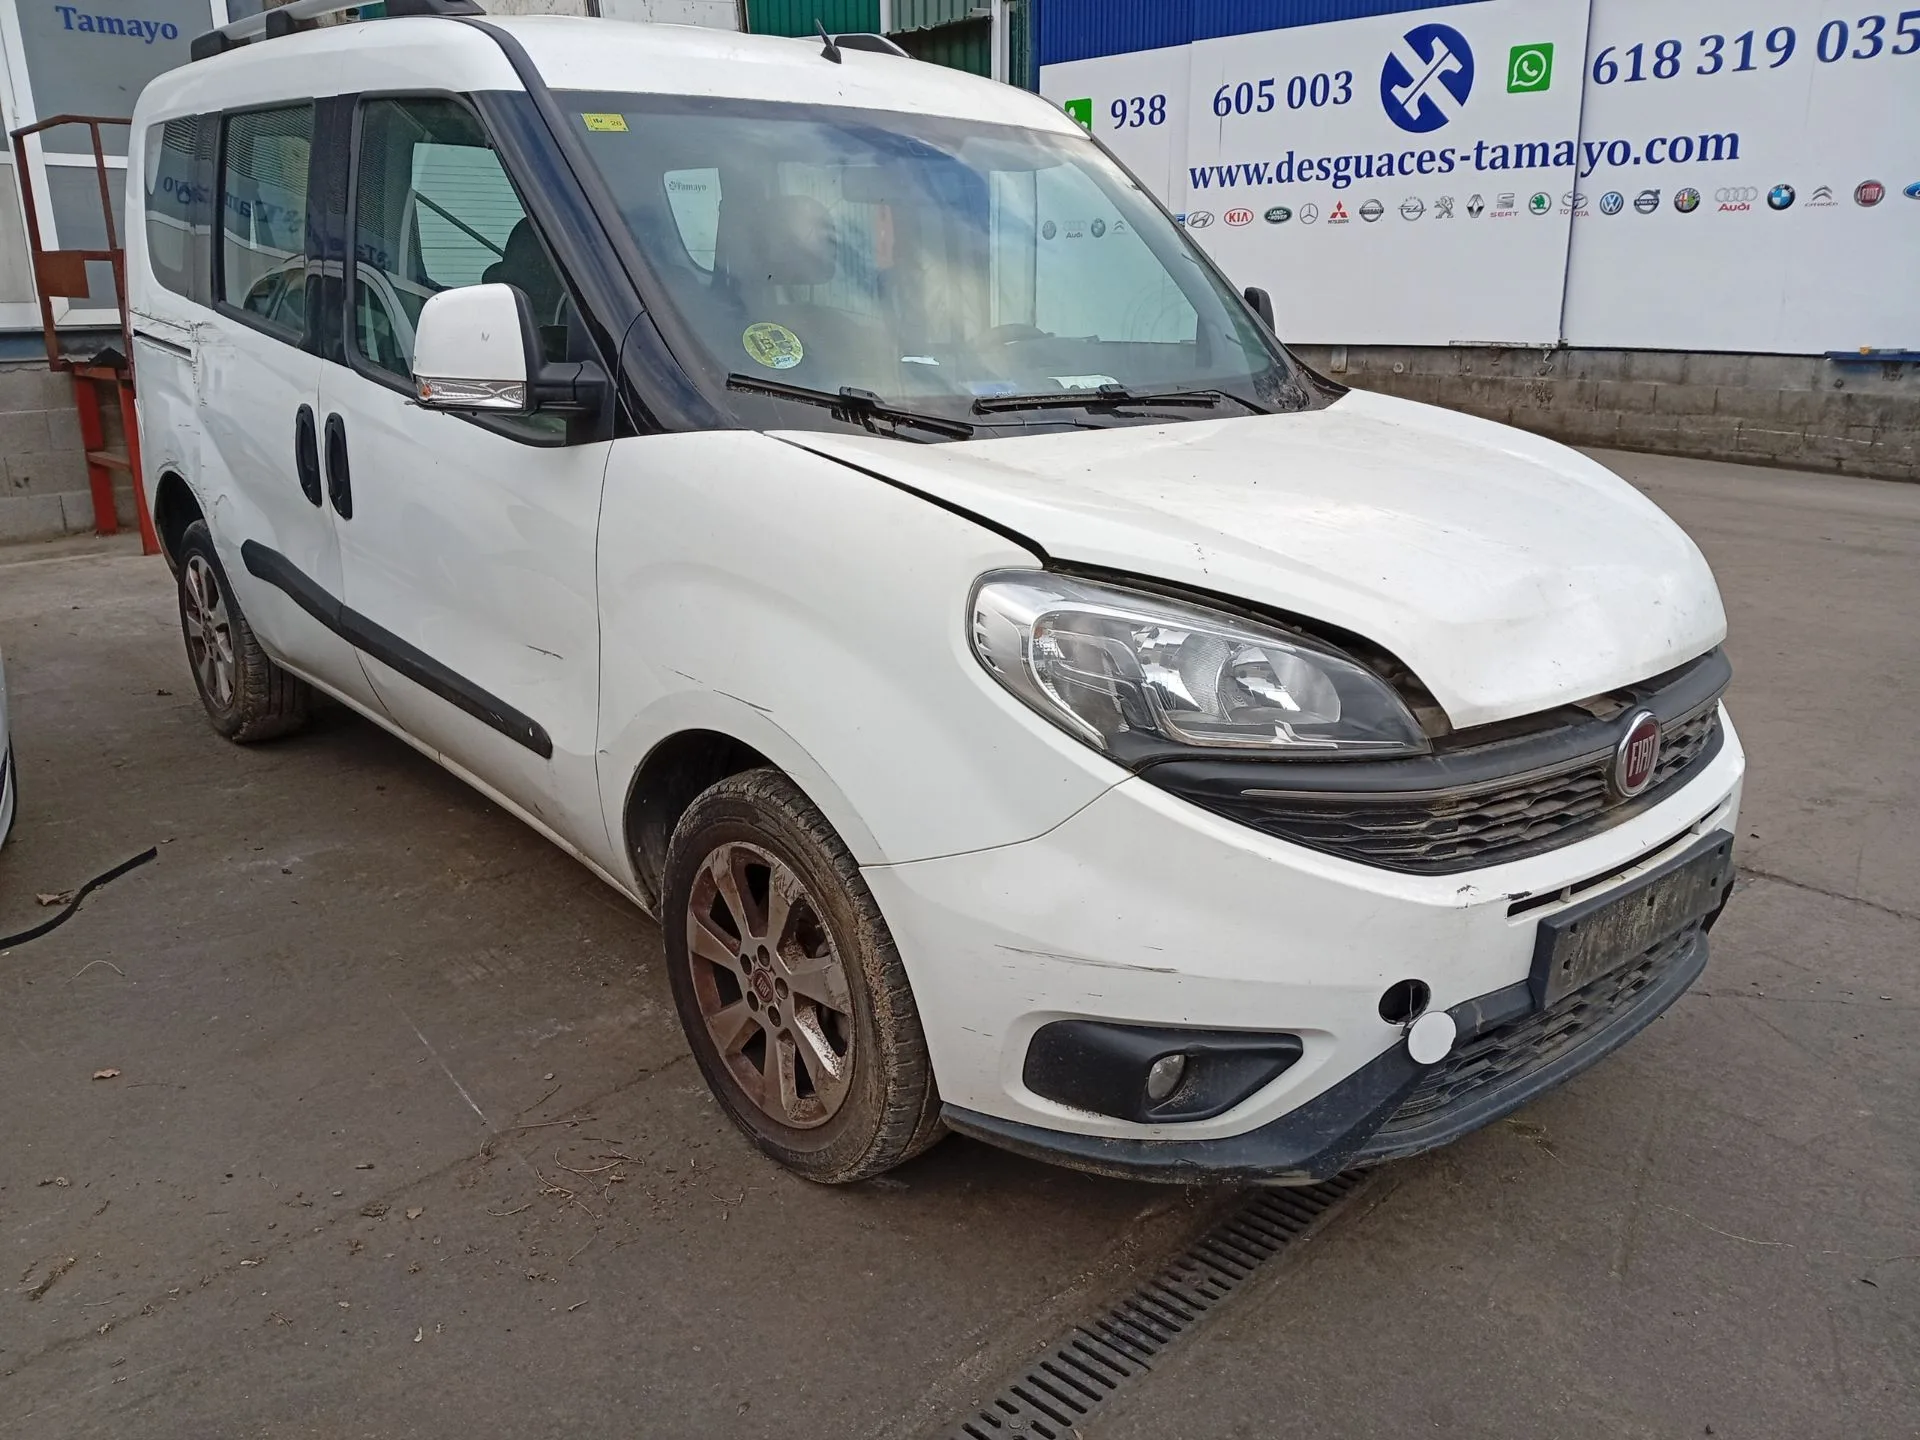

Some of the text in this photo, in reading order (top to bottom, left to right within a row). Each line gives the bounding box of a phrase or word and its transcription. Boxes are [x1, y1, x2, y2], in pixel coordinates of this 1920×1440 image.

[55, 5, 178, 44] Tamayo
[1110, 10, 1920, 129] 938 605 003 618 319 035
[1189, 131, 1740, 189] www.desguaces-tamayo.com
[1228, 212, 1248, 222] KIA
[1628, 734, 1655, 778] FIAT
